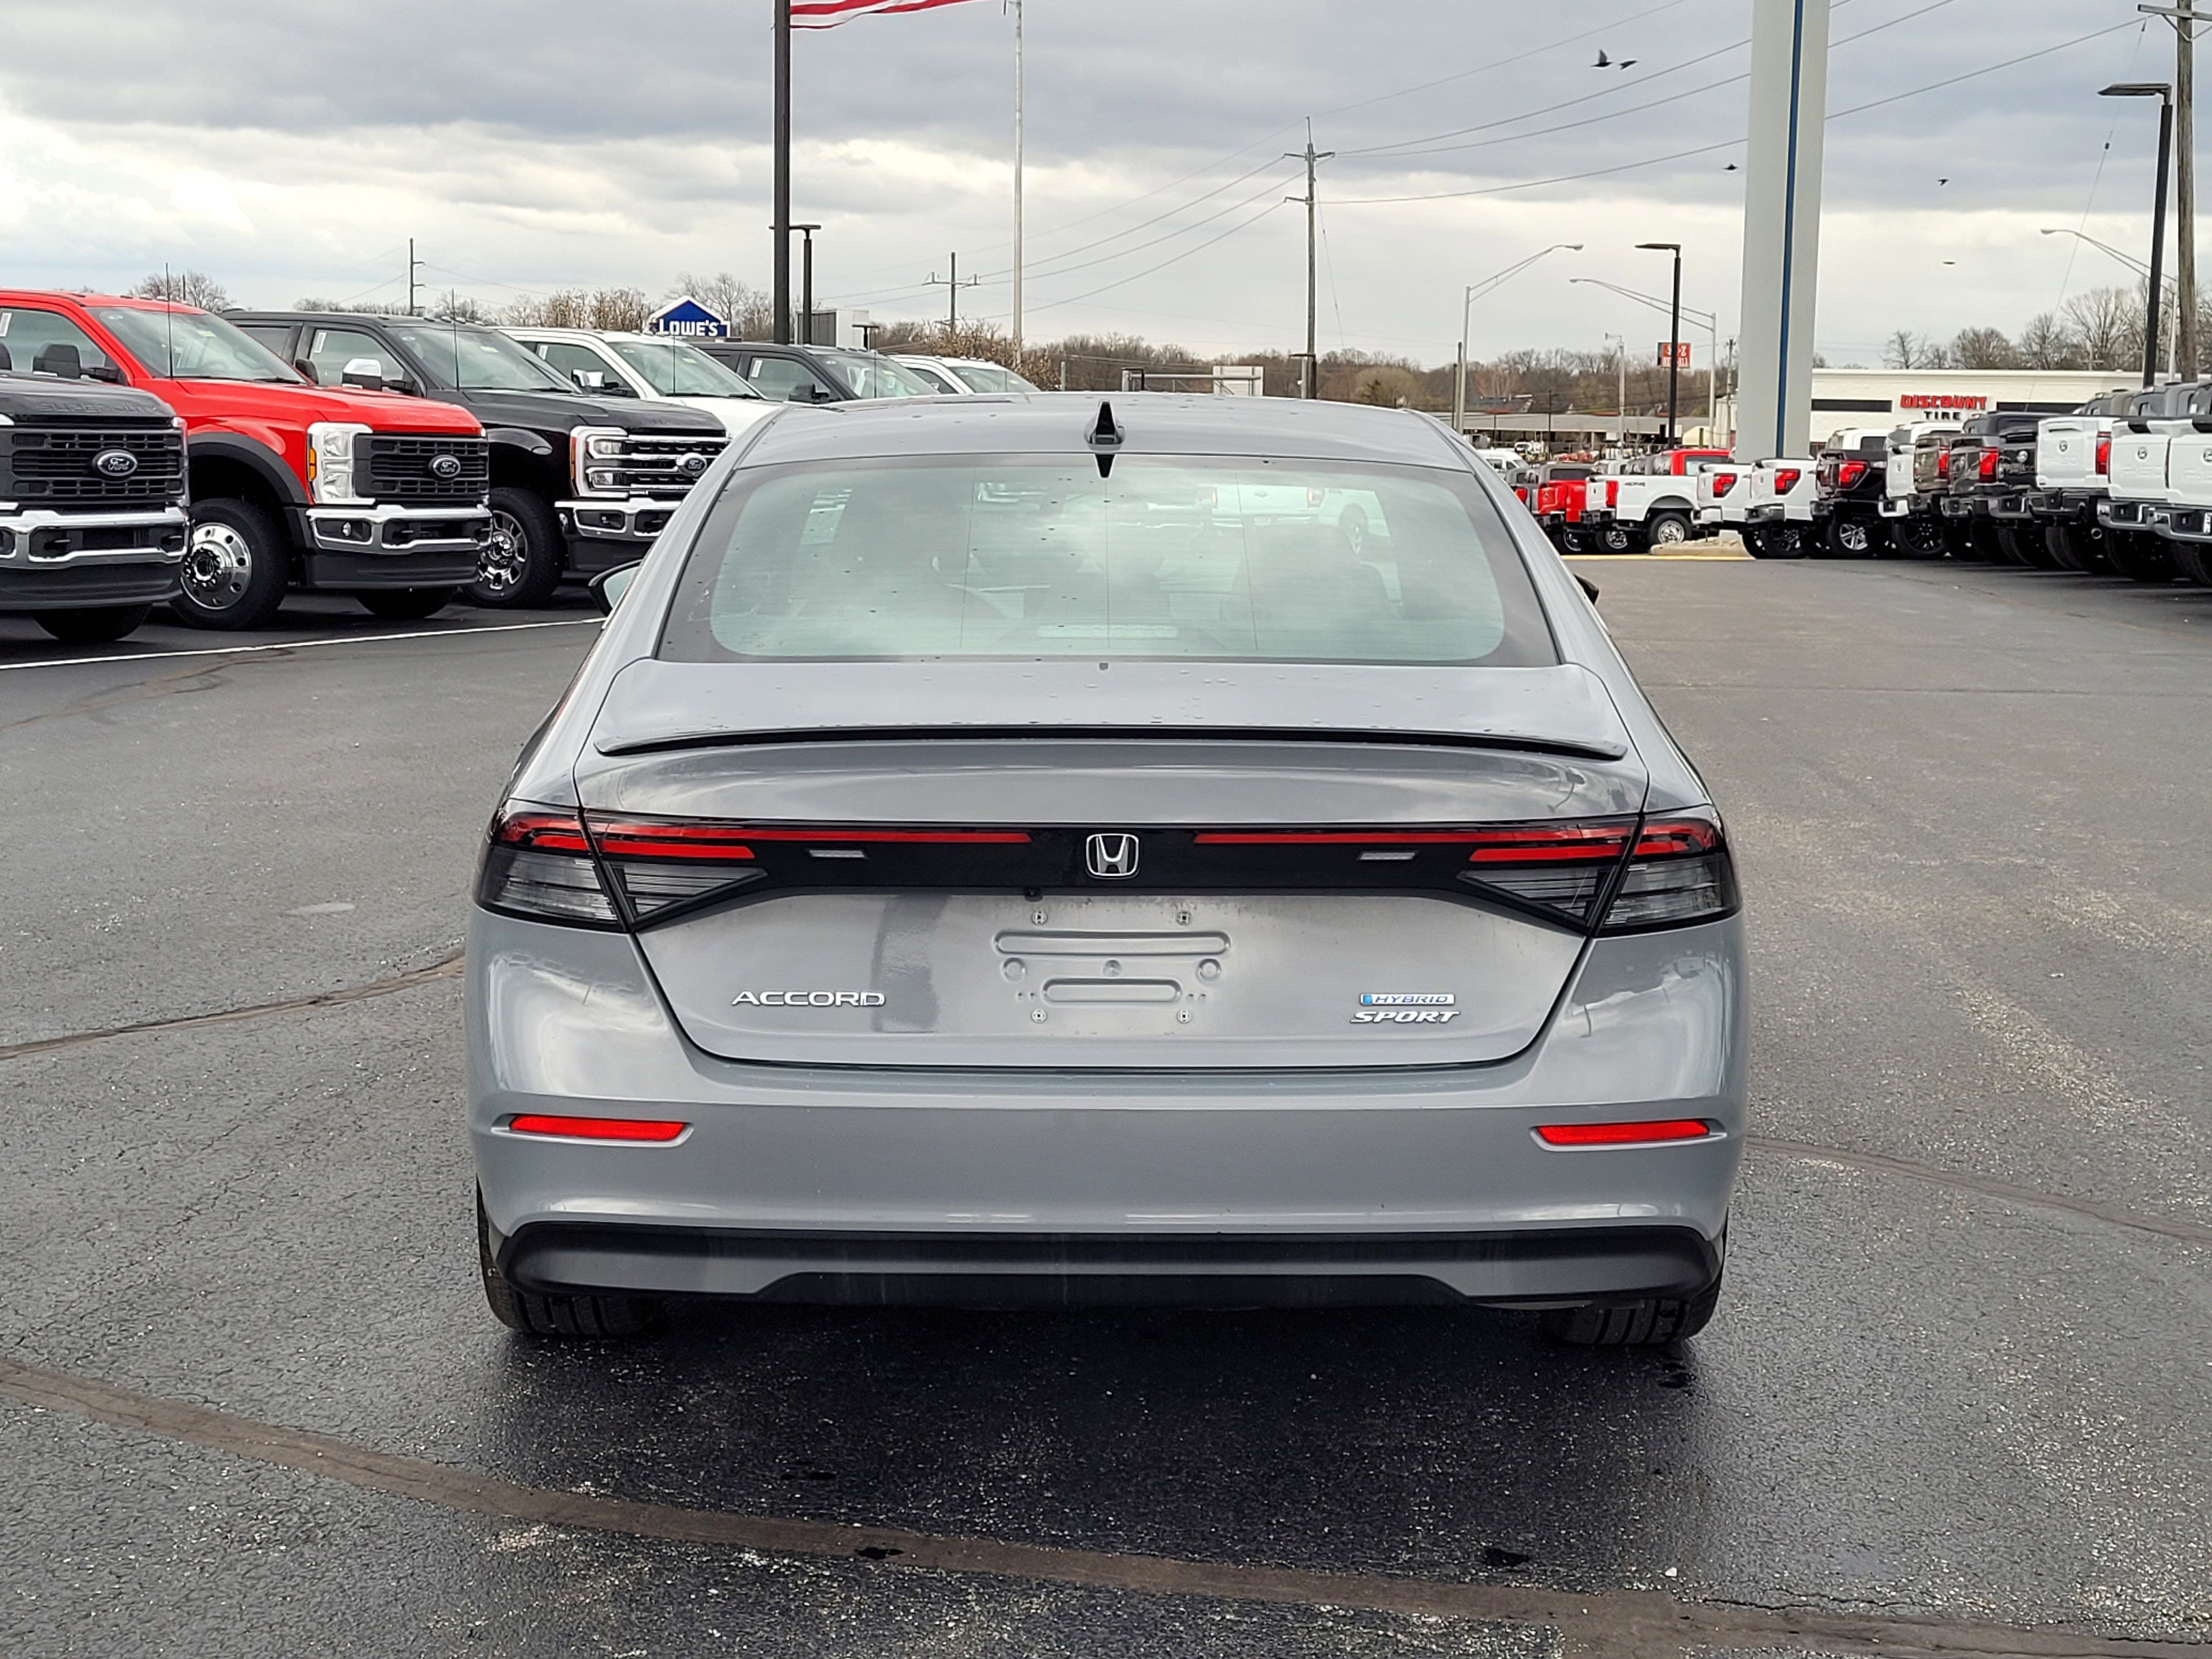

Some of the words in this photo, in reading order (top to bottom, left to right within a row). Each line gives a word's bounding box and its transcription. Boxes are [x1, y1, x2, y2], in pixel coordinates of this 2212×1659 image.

[659, 319, 718, 336] LOWE'S
[1900, 394, 1987, 410] DISCOUNT
[1923, 411, 1961, 420] TIRE
[731, 991, 885, 1006] ACCORD
[1350, 1011, 1460, 1023] SPORT
